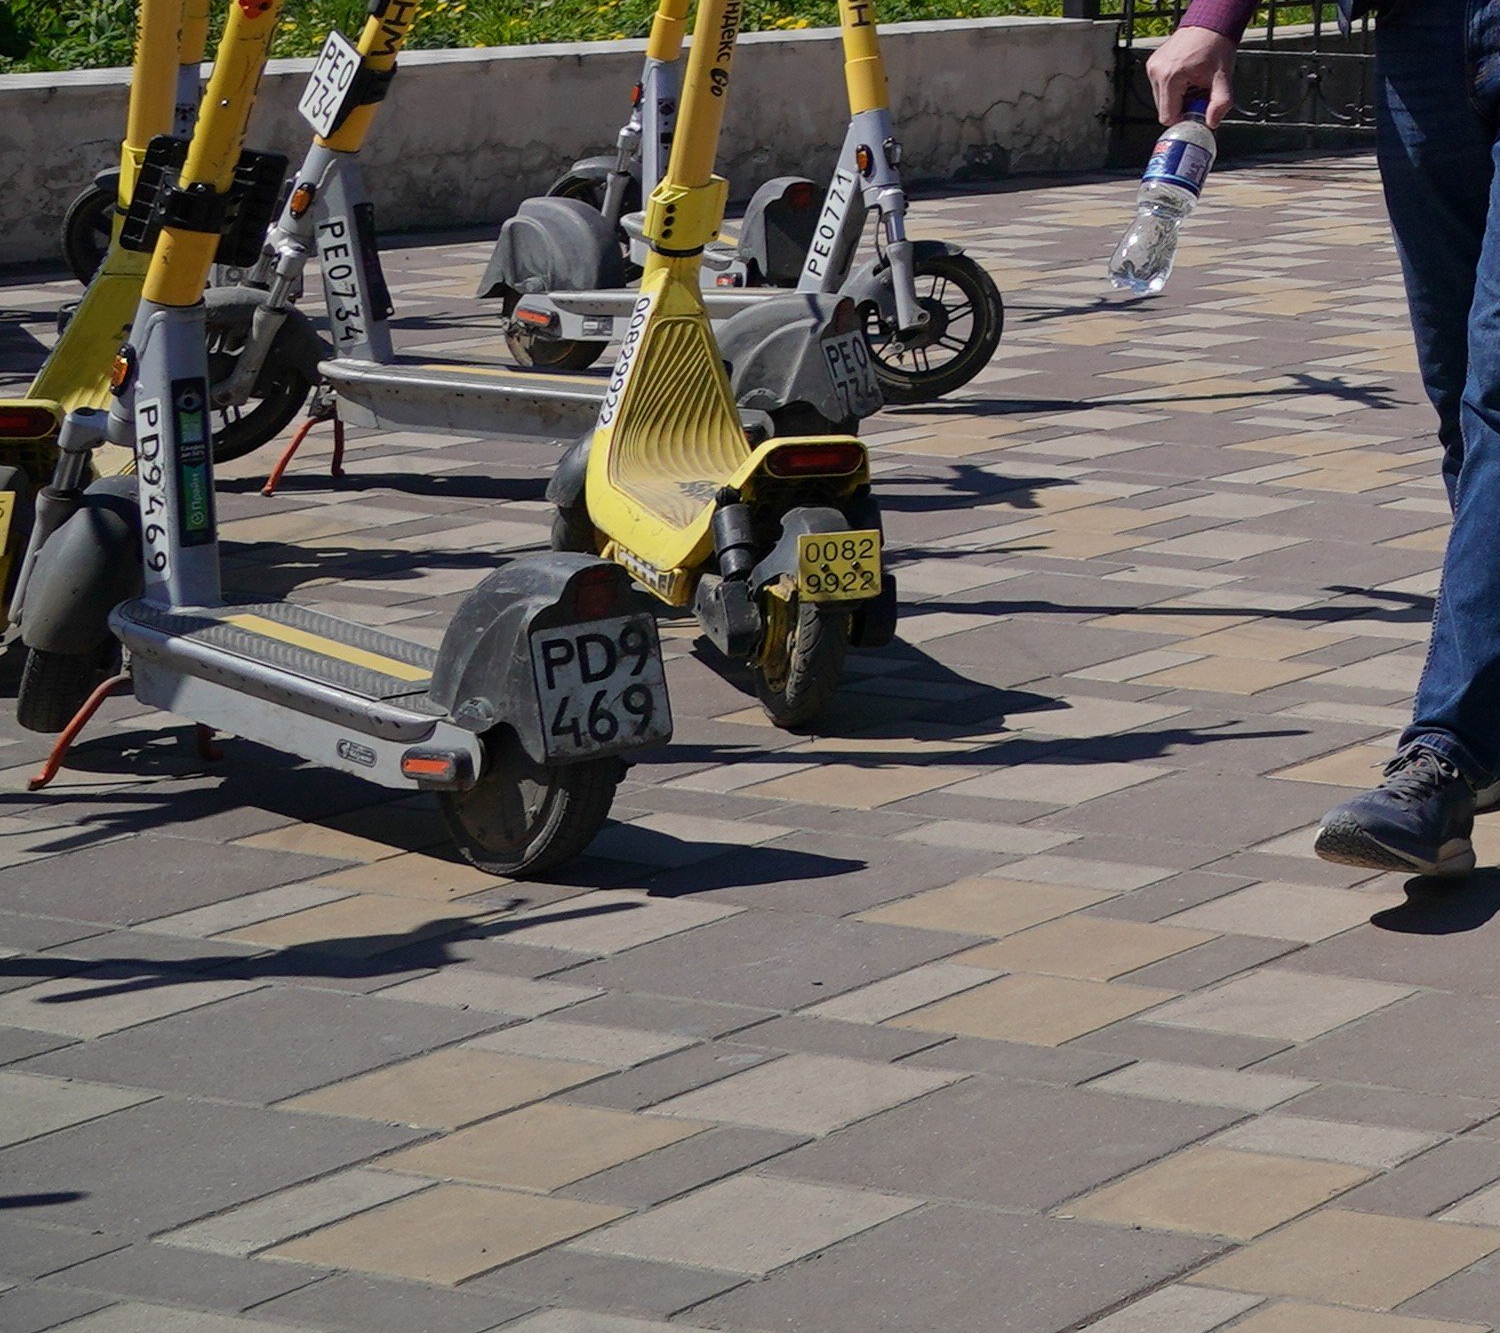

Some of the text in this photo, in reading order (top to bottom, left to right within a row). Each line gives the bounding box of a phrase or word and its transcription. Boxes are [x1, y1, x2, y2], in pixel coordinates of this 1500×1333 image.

[303, 76, 337, 127] 734
[710, 67, 728, 96] Go
[139, 404, 167, 572] PD9469
[805, 538, 874, 563] 0082
[805, 571, 878, 594] 9922
[542, 623, 652, 690] PD9
[552, 684, 653, 747] 469
